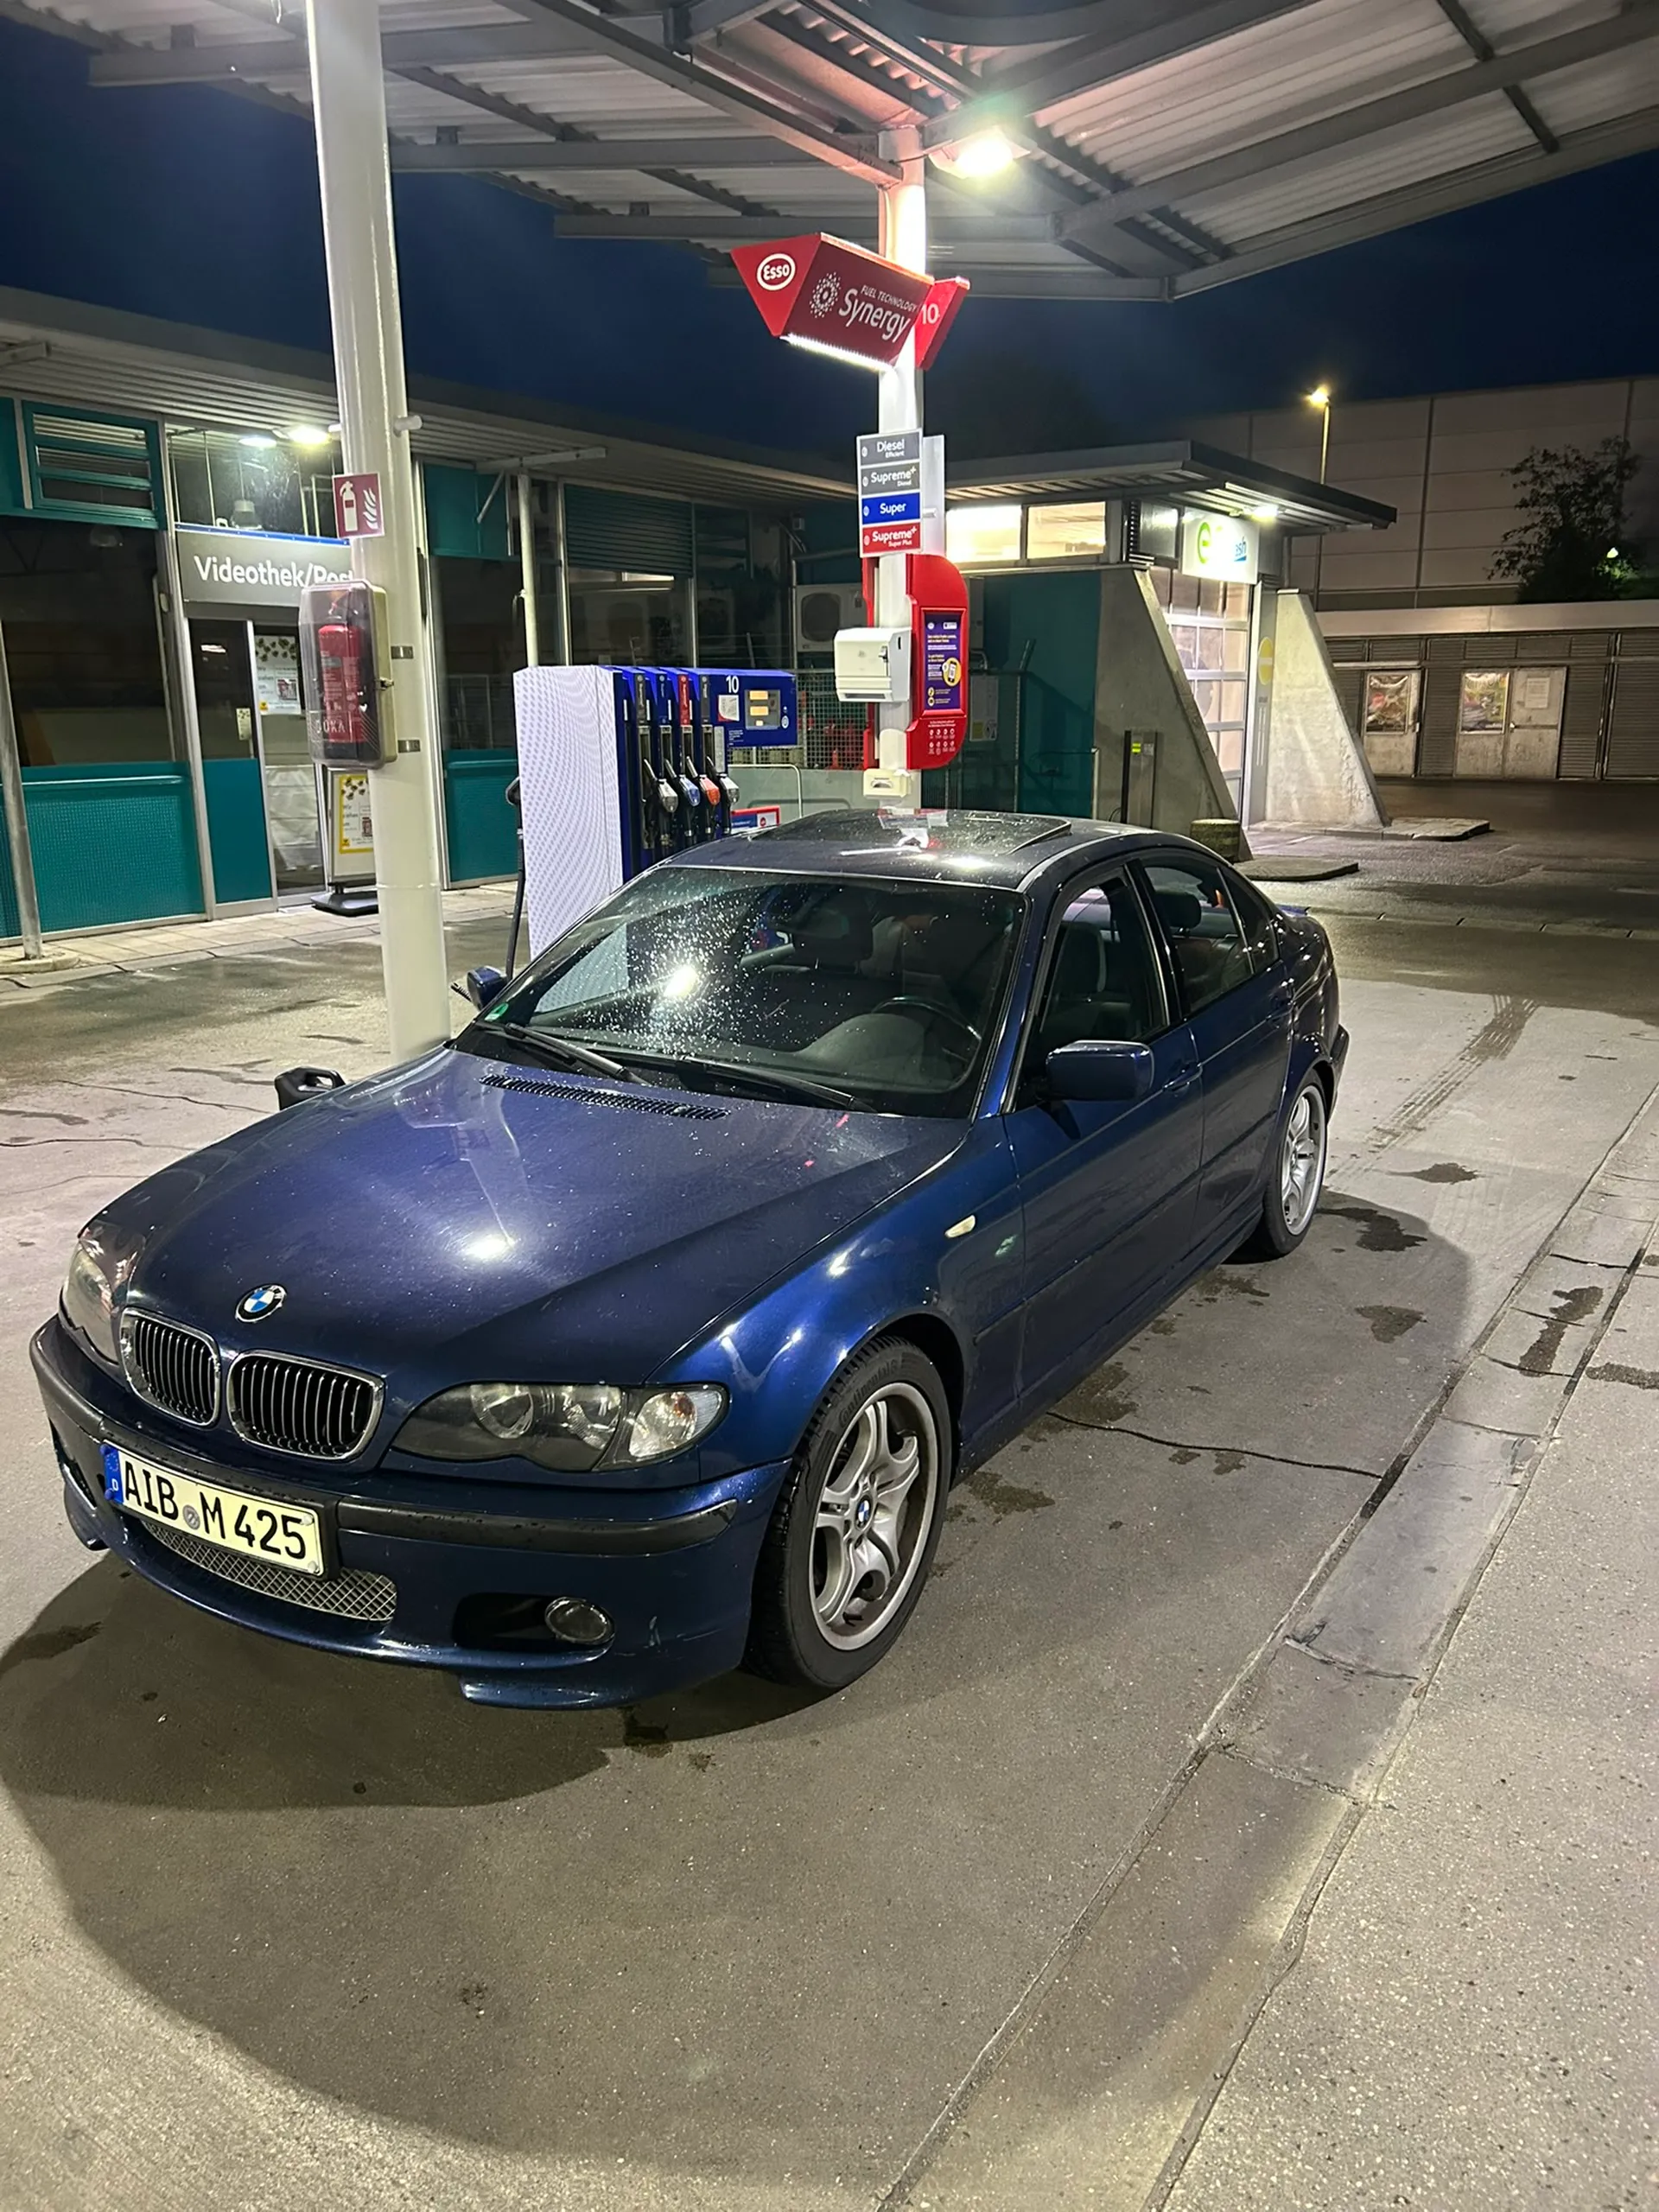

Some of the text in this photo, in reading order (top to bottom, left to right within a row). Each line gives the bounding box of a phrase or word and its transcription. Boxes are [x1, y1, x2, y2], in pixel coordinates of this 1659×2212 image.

[763, 264, 791, 282] Esso
[861, 284, 918, 312] FUEL TECHNOLOGY
[838, 288, 912, 343] Synergy
[921, 302, 939, 325] 10
[877, 438, 906, 453] Diesel
[880, 502, 907, 517] Super
[725, 674, 740, 694] 10
[111, 1477, 119, 1491] D
[125, 1460, 306, 1560] AIB M 425
